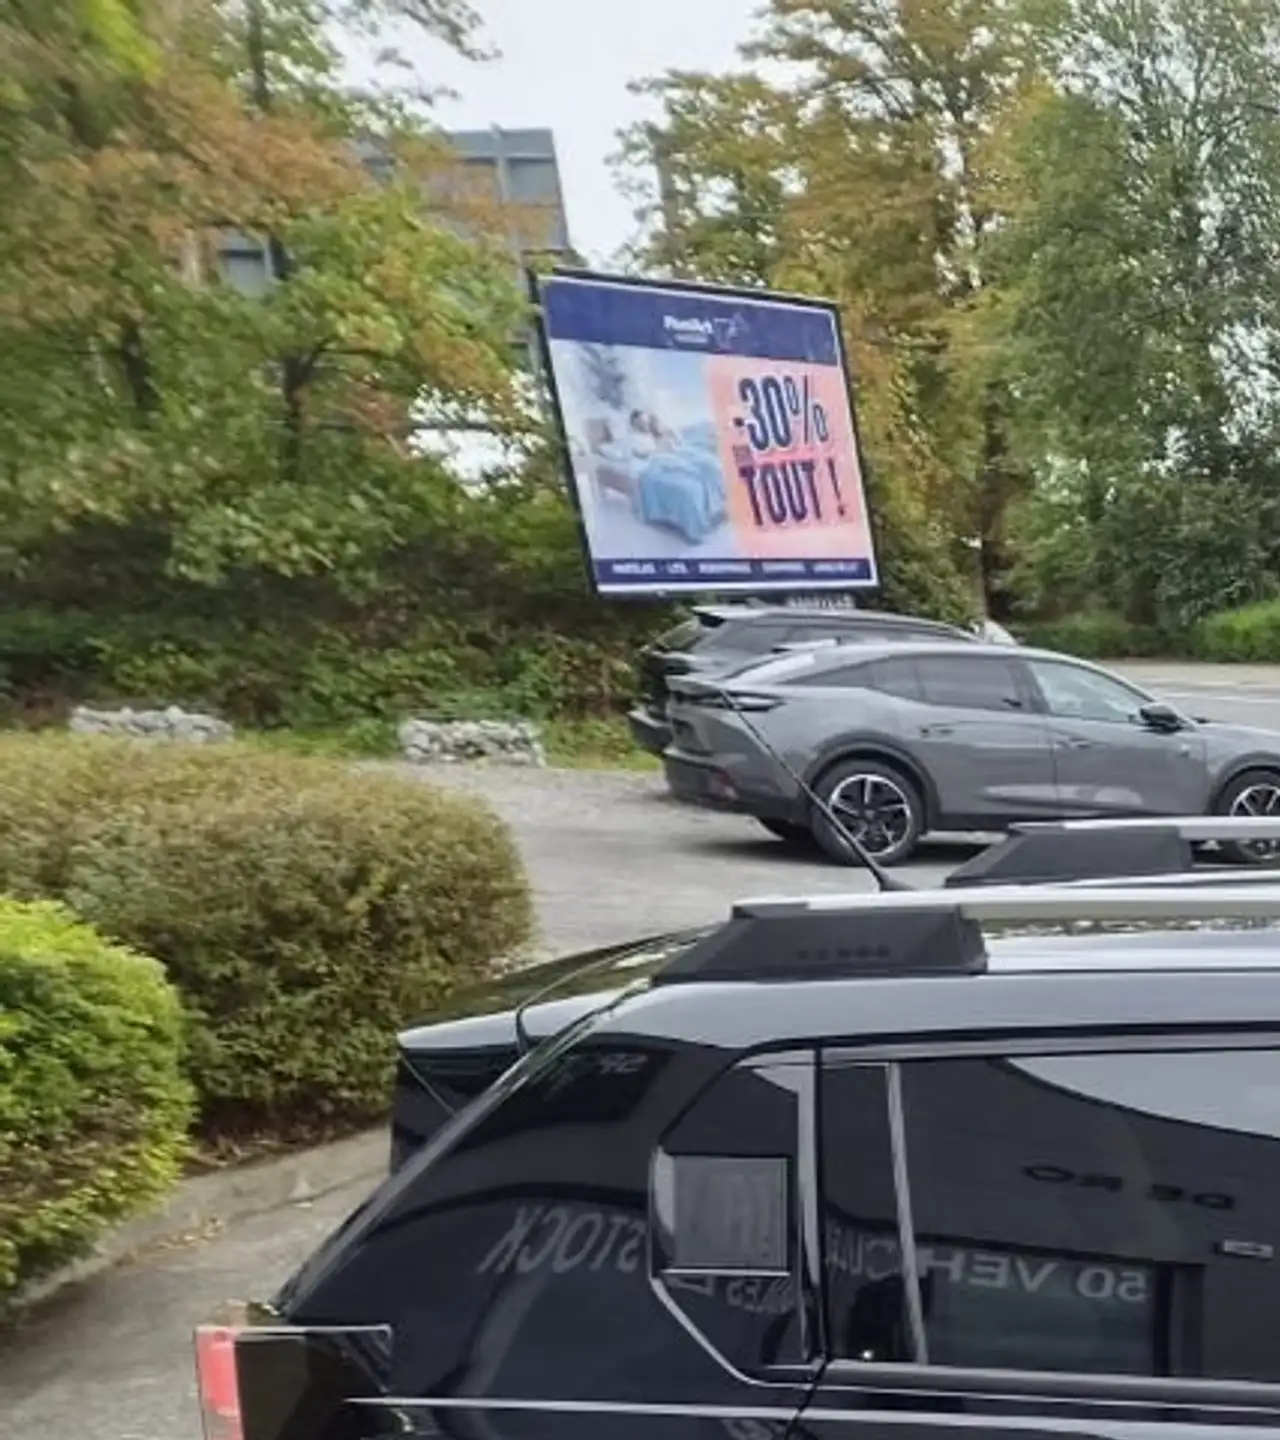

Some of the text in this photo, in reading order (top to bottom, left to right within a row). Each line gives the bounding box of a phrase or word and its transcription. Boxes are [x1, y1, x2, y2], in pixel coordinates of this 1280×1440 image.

[733, 375, 829, 451] -30%
[738, 457, 846, 526] TOUT !
